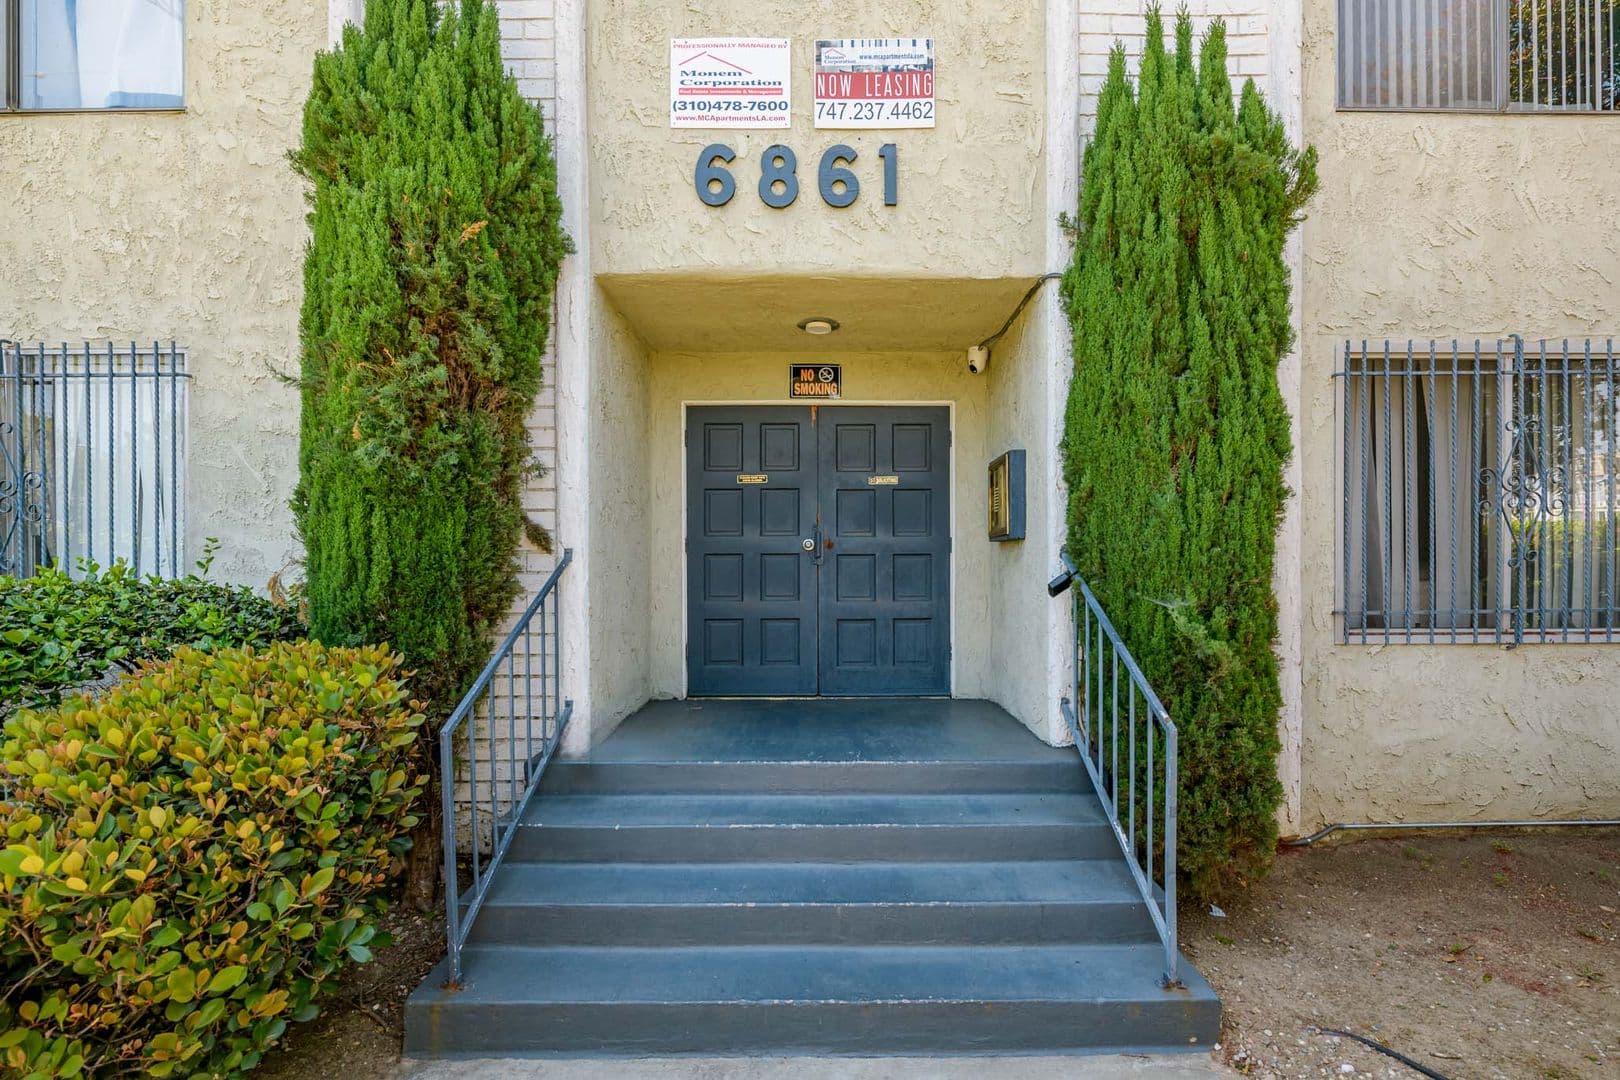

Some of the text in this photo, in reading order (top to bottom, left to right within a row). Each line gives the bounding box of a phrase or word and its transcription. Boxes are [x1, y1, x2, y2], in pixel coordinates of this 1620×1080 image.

[680, 79, 782, 87] Corporation
[817, 72, 933, 97] NOW LEASING
[673, 101, 788, 112] (310)478-7600
[816, 101, 934, 121] 747.237.4462
[695, 143, 897, 209] 6861
[800, 369, 815, 381] NO
[794, 382, 838, 395] SMOKING
